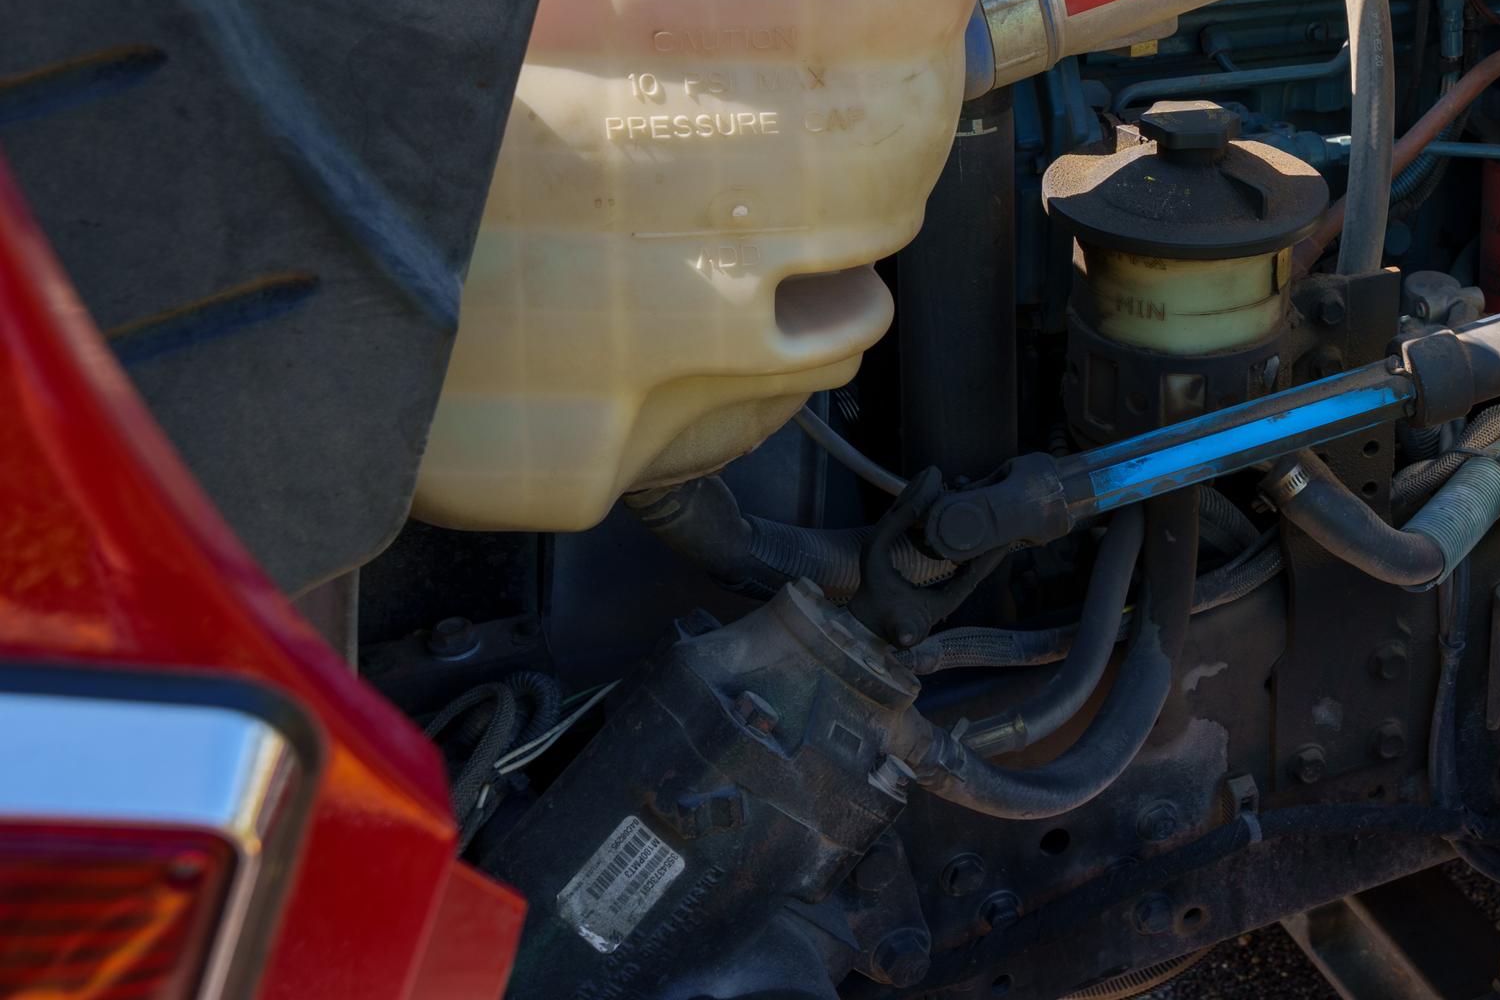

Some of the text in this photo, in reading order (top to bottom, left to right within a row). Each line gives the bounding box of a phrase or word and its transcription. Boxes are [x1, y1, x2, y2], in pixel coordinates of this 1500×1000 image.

[653, 27, 797, 53] CAUTION
[628, 72, 658, 96] 10
[684, 71, 735, 95] PSI
[605, 111, 779, 140] PRESSURE
[696, 246, 761, 270] ADD
[1116, 296, 1167, 321] MIN
